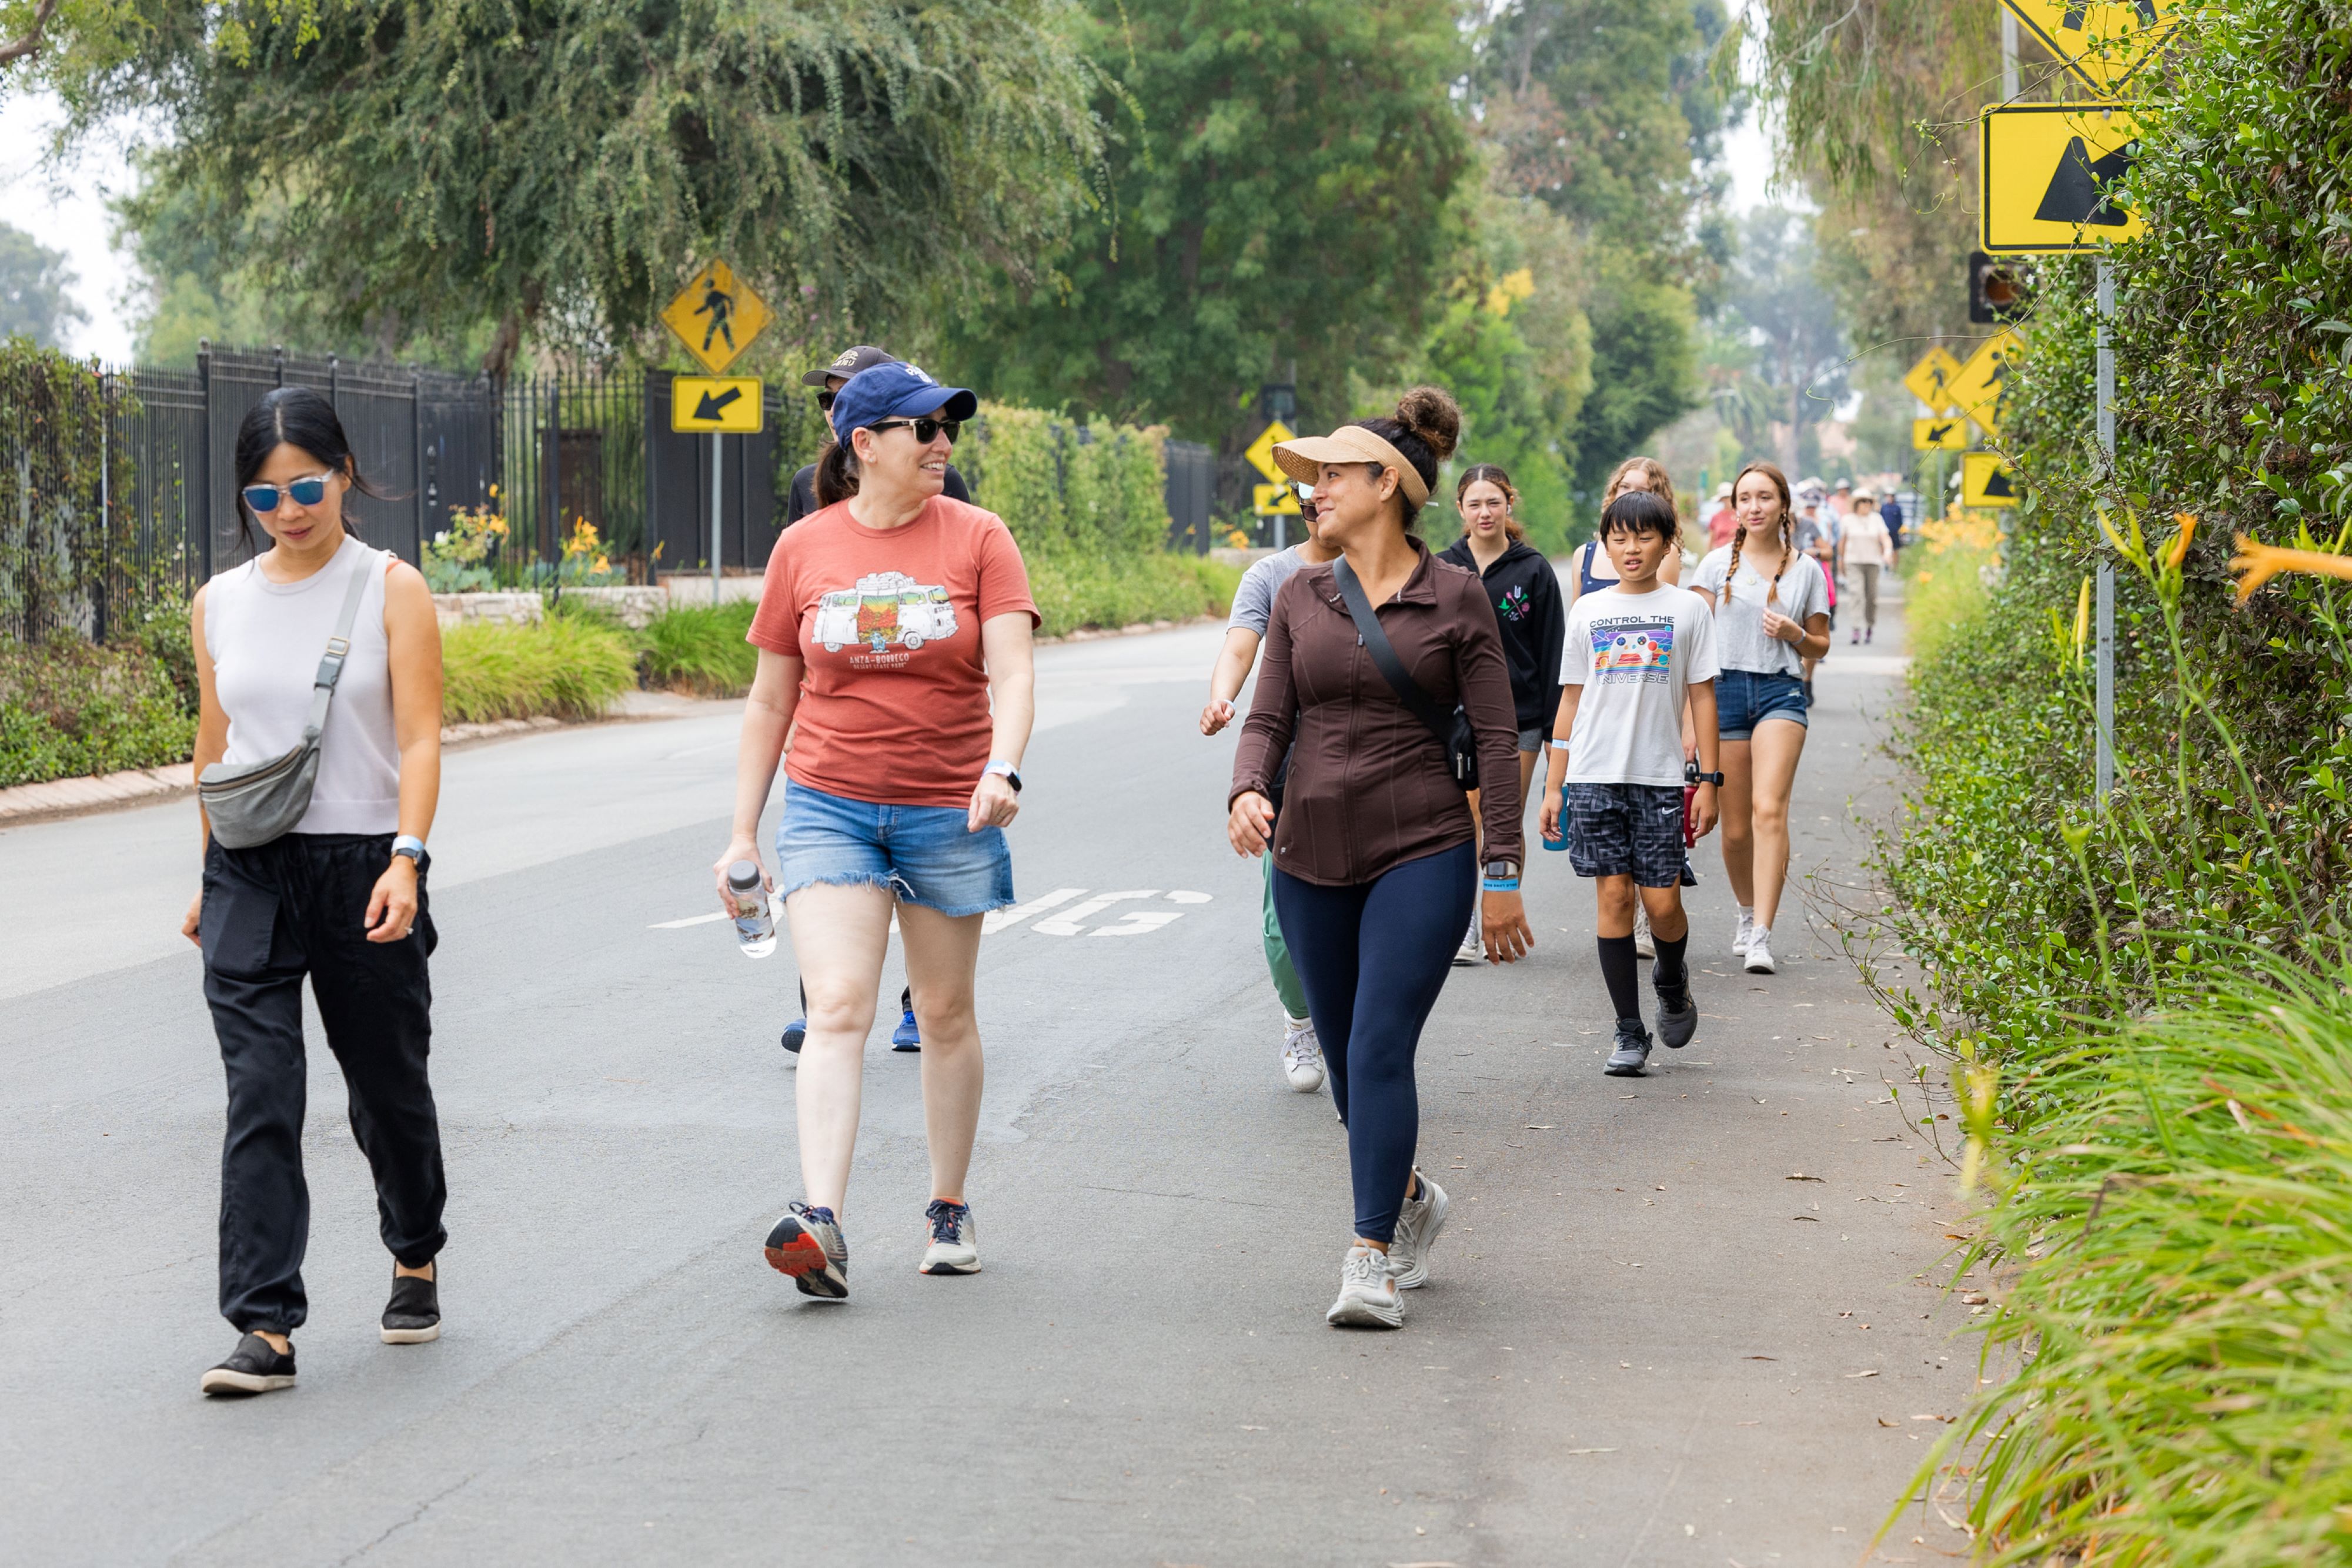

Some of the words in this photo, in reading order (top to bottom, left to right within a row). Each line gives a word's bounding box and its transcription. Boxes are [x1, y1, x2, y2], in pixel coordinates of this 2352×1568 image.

[1589, 616, 1645, 628] CONTROL
[1650, 616, 1675, 624] THE
[849, 653, 910, 664] ANZA-BORREGO
